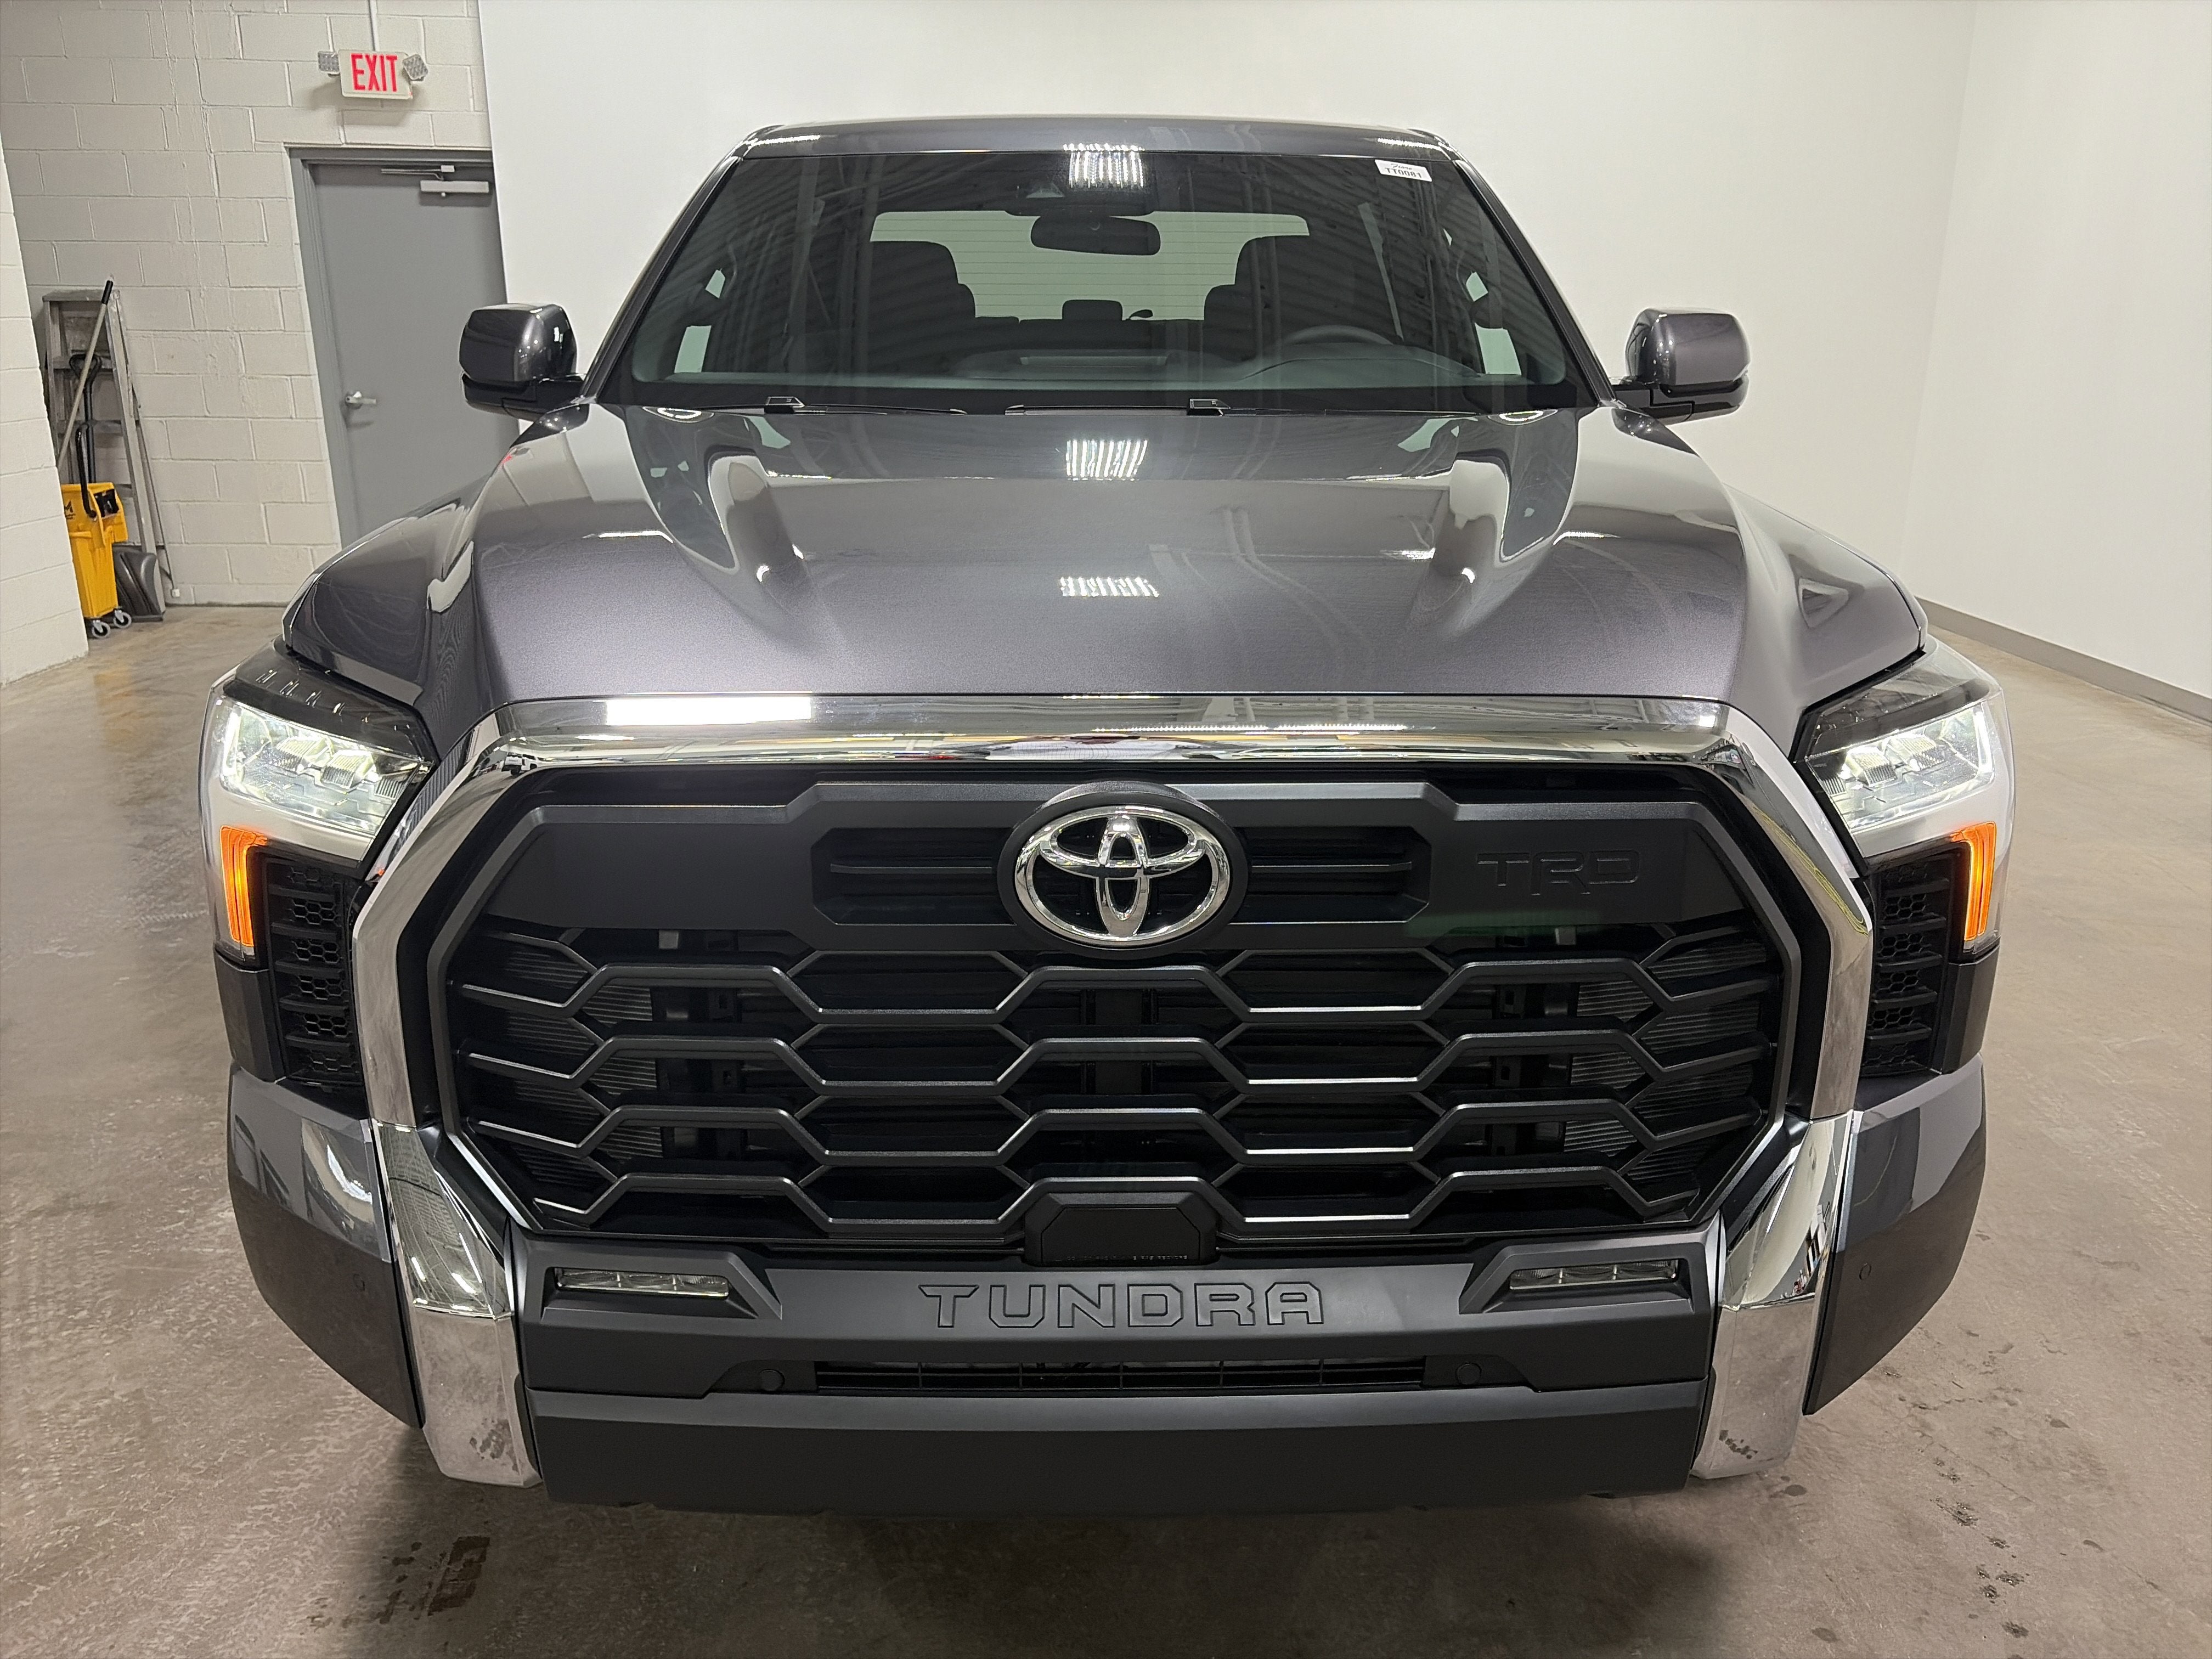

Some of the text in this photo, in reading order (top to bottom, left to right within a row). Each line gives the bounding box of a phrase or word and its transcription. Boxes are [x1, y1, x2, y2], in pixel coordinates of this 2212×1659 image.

[351, 53, 398, 92] EXIT
[1476, 850, 1639, 896] TRD
[918, 1281, 1324, 1328] TUNDRA
